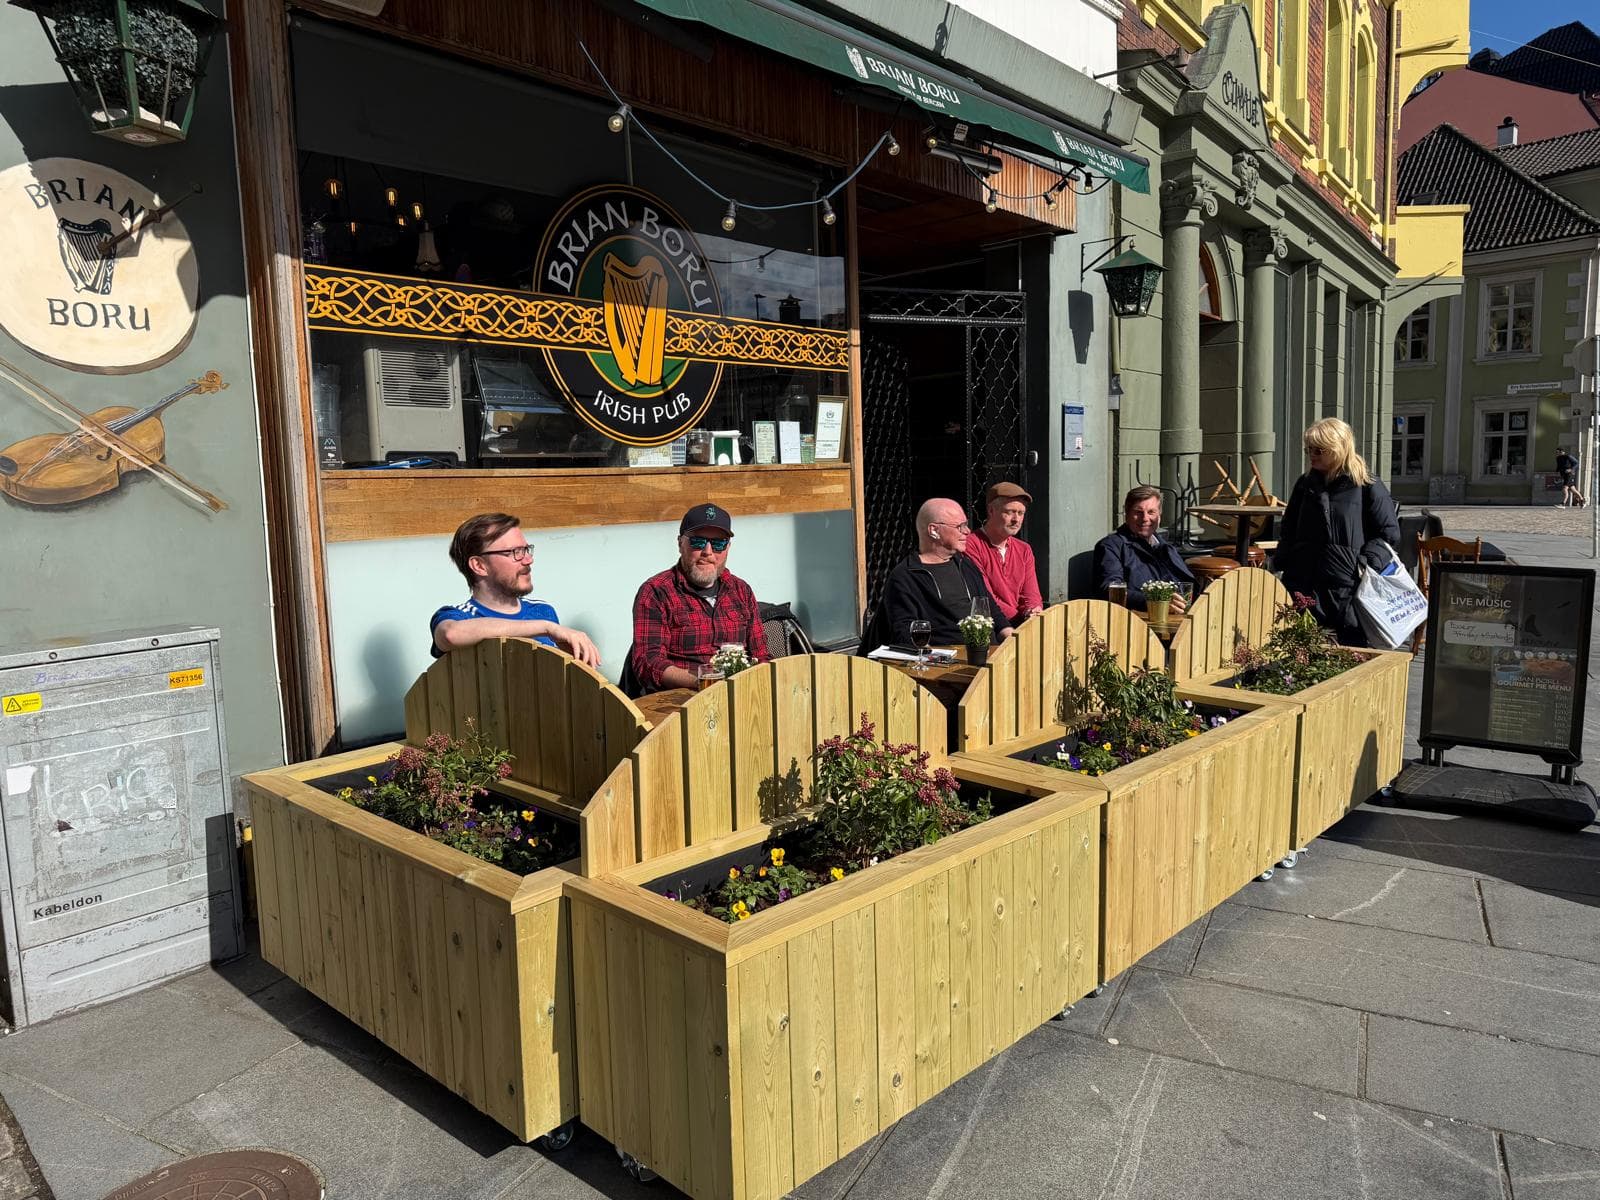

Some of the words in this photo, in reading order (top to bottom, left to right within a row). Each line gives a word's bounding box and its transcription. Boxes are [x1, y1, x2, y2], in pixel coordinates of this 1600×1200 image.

[866, 56, 917, 90] BRIAN
[917, 77, 961, 105] BORU
[1065, 137, 1099, 160] BRIAN
[1098, 150, 1125, 172] BORU
[24, 177, 145, 221] BRIAN
[548, 200, 630, 293] BRIAN
[639, 206, 713, 308] BORU
[47, 298, 151, 331] BORU
[594, 390, 646, 424] IRISH
[653, 392, 692, 424] PUB
[1450, 597, 1473, 607] LIVE
[1475, 598, 1513, 609] MUSIC
[169, 673, 203, 685] KS71356
[1497, 680, 1535, 689] GOURMET
[1535, 682, 1547, 690] PIE
[1548, 683, 1572, 692] MENU
[33, 894, 103, 919] Kabeldon
